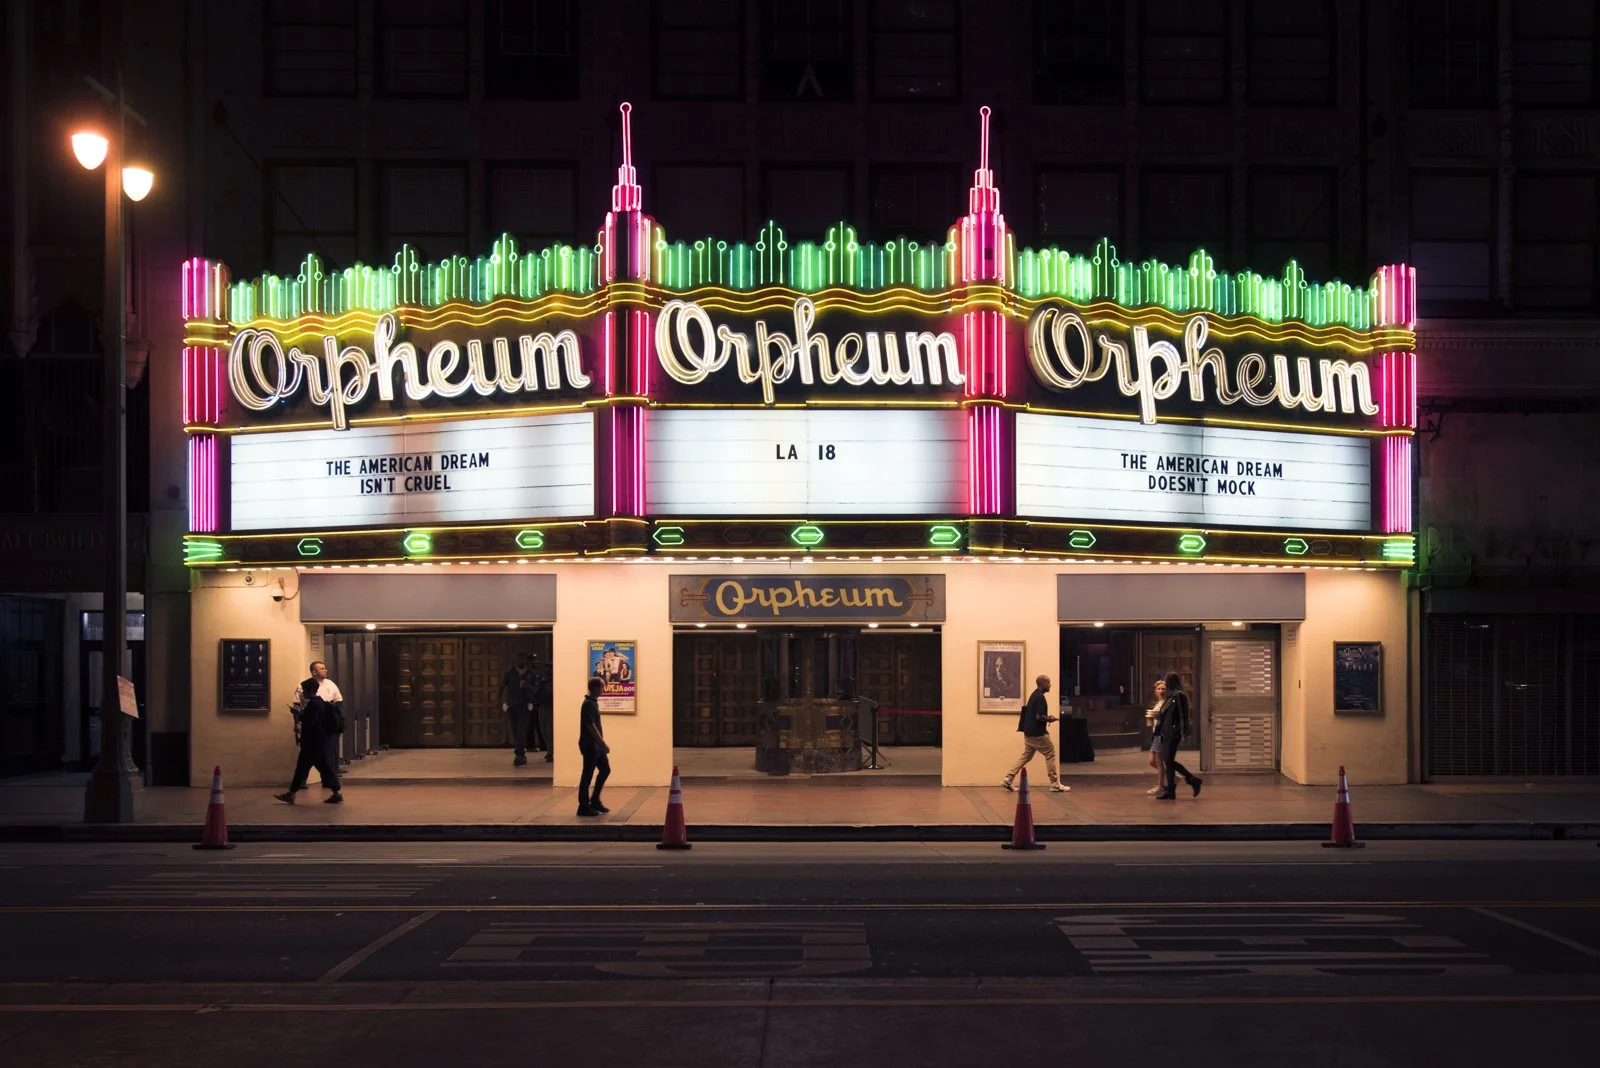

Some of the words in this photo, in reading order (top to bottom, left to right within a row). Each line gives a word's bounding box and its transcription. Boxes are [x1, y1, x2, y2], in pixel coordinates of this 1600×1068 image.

[655, 296, 965, 405] Orpheum
[1026, 302, 1379, 425] Orpheum
[227, 312, 591, 431] Orpheum
[326, 460, 351, 476] THE
[359, 455, 432, 475] AMERICAN
[441, 452, 490, 470] DREAM
[776, 444, 798, 460] LA
[1121, 453, 1147, 470] THE
[1156, 455, 1228, 475] AMERICAN
[1237, 461, 1283, 478] DREAM
[360, 477, 396, 494] ISN'T
[404, 474, 451, 492] CRUEL
[1148, 475, 1208, 493] DOESN'T
[1217, 479, 1256, 496] MOCK
[715, 580, 903, 615] Orpheum
[438, 922, 873, 977] KEEP
[1053, 913, 1514, 975] CLEAR
